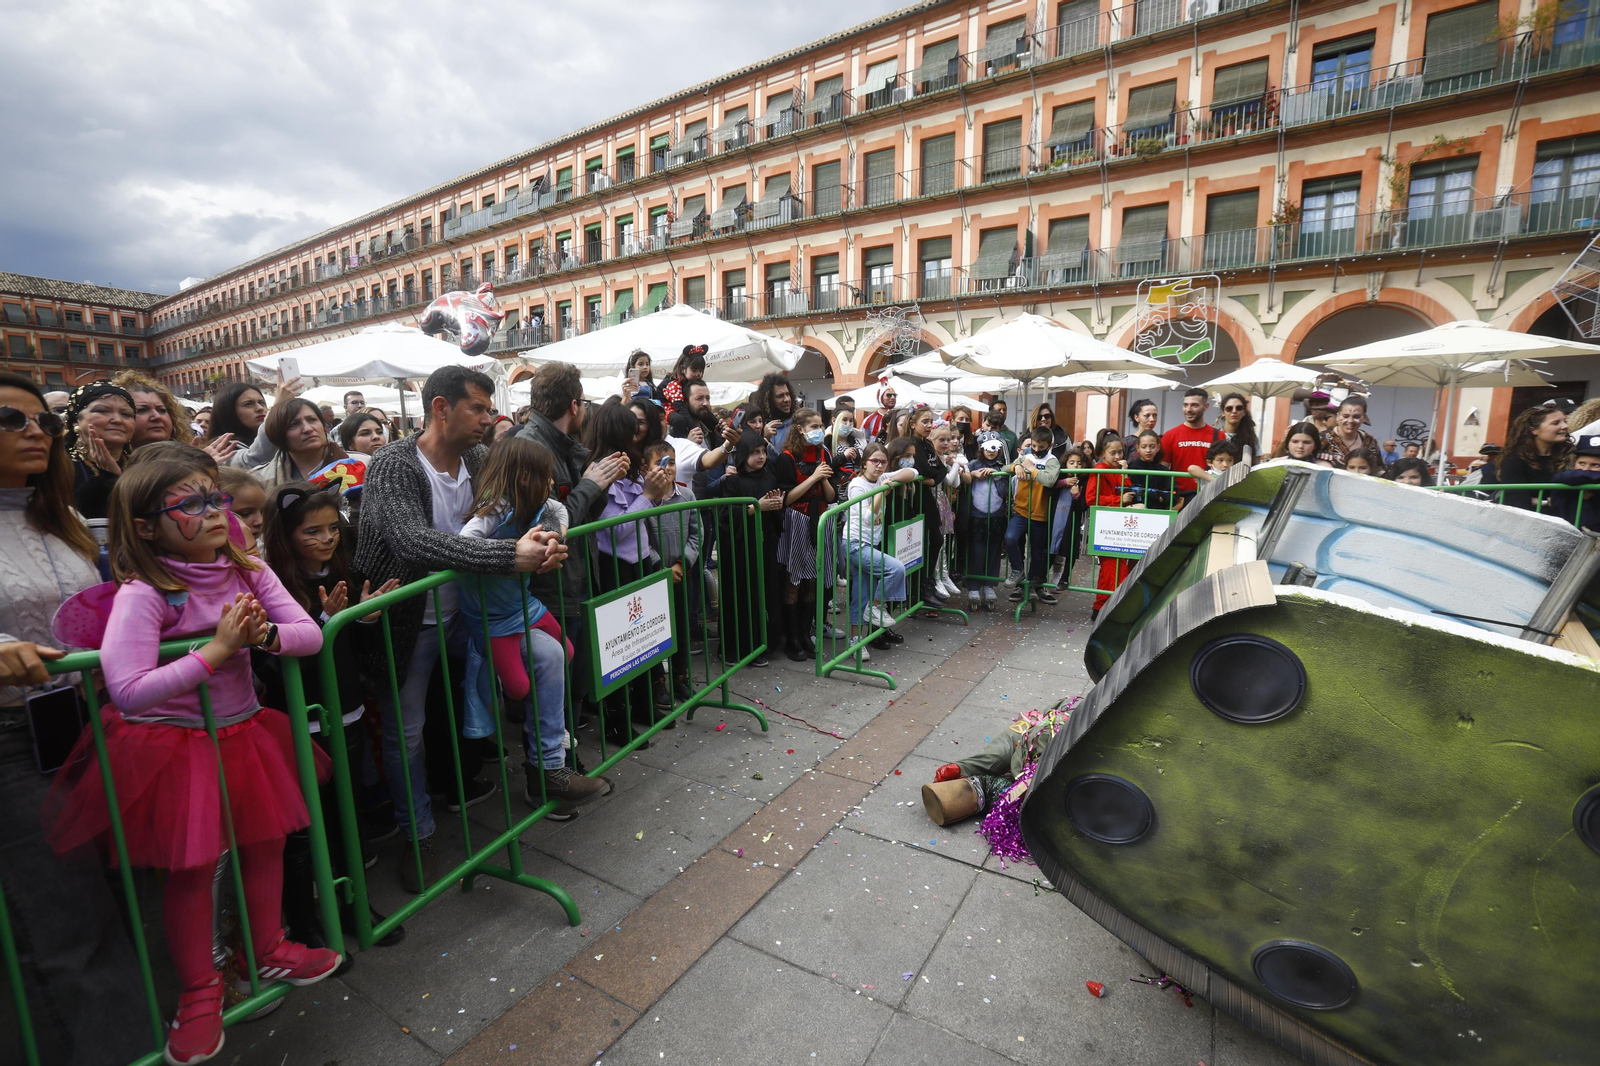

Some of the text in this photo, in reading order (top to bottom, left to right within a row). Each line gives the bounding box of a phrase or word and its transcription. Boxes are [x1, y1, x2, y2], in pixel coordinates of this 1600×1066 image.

[1178, 440, 1211, 449] SUPREME
[1100, 529, 1133, 537] AYUNTAMIENTO
[605, 627, 640, 651] AYUNTAMIENTO
[640, 622, 646, 633] DE
[624, 643, 631, 652] de
[631, 626, 666, 647] Infraestructuras
[610, 648, 659, 679] PERDONEN LAS MOLESTIAS
[622, 651, 636, 661] Equipo
